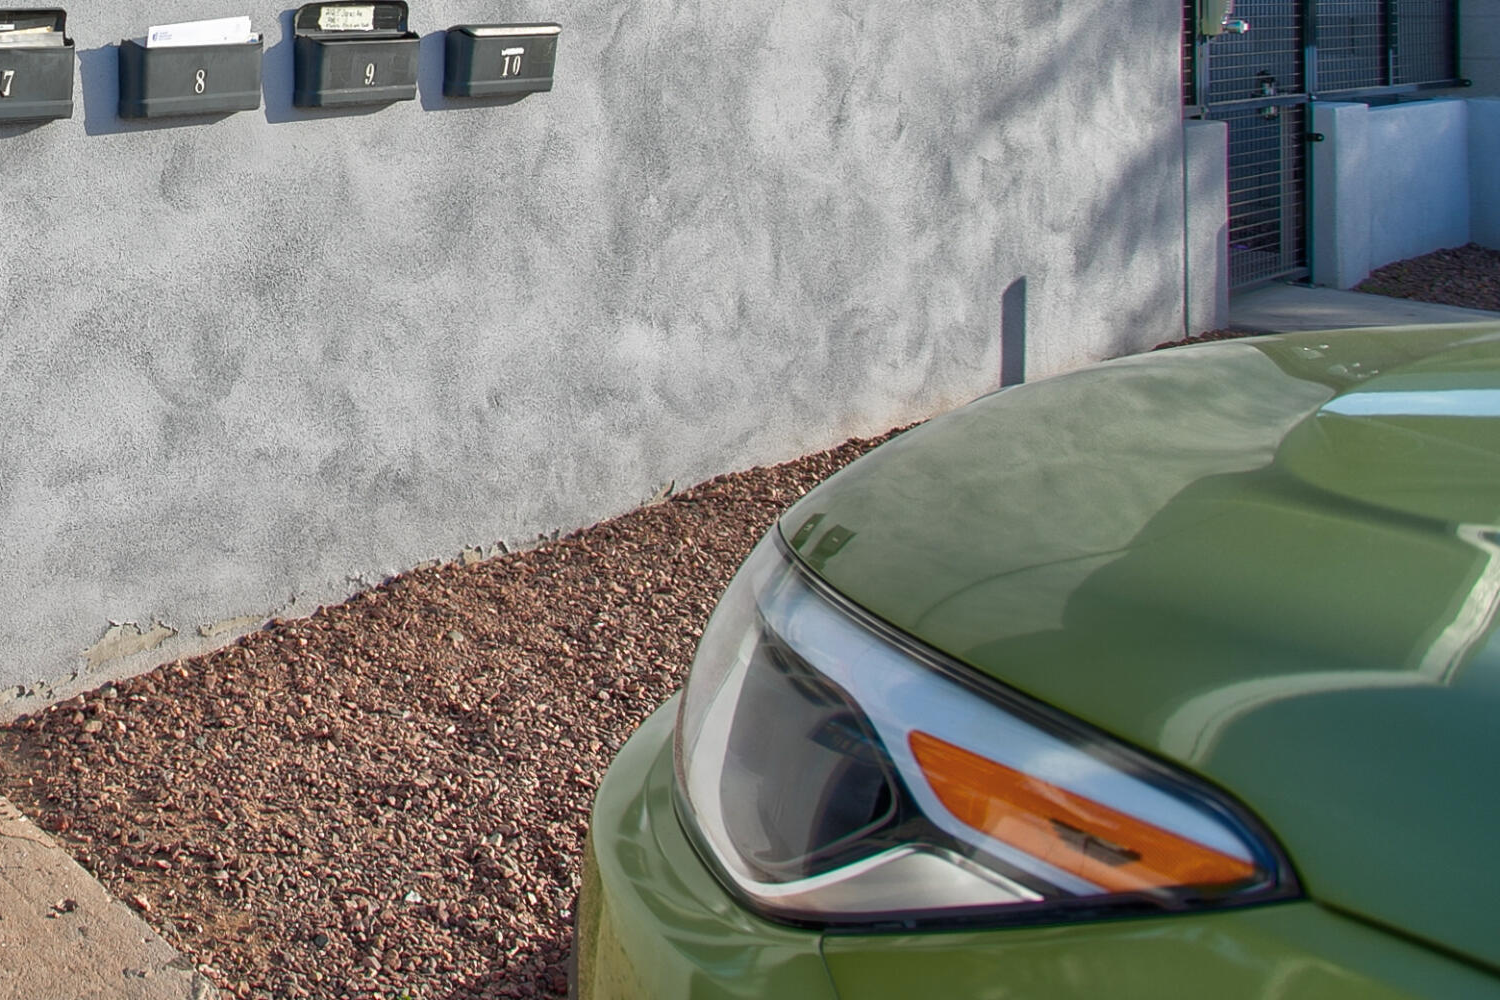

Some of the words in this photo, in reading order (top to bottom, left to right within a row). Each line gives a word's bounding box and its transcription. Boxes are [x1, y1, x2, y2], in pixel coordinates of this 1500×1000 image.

[502, 55, 521, 77] 10
[3, 70, 15, 97] 7
[195, 69, 205, 94] 8
